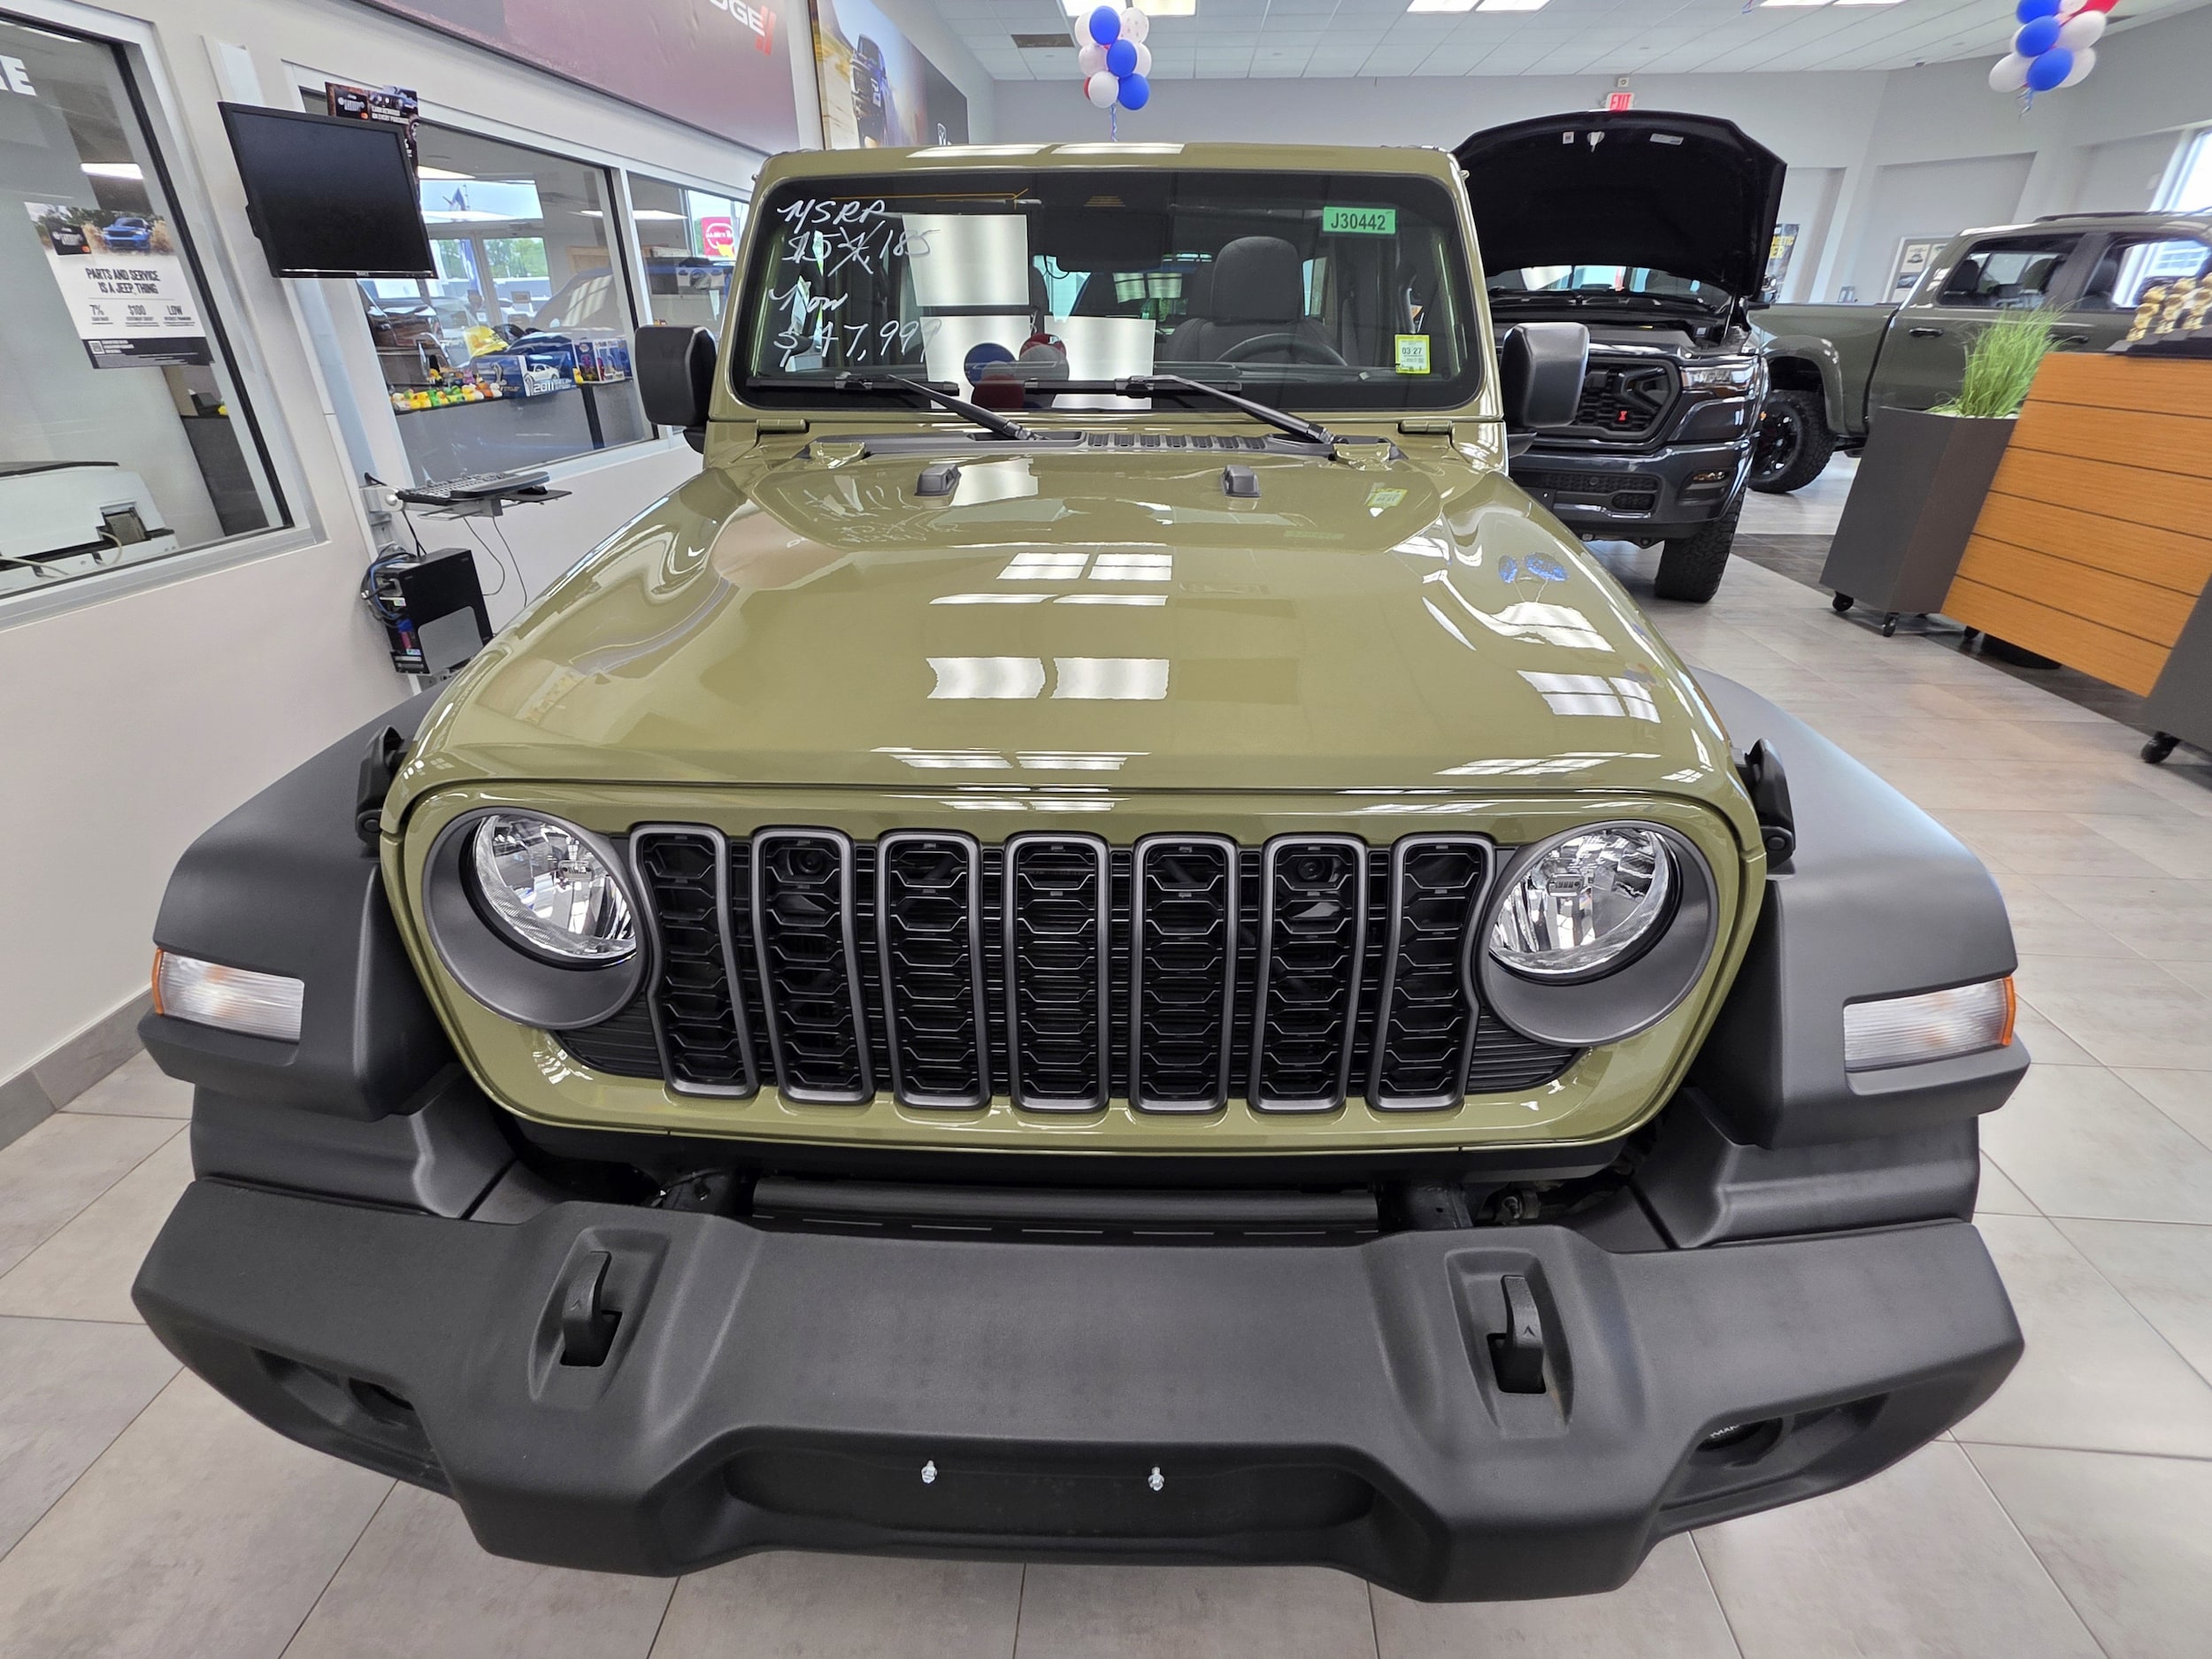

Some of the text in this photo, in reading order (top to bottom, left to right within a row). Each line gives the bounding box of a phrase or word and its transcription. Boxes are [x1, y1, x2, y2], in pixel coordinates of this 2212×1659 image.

[0, 55, 36, 96] E
[1609, 93, 1632, 111] EXIT
[777, 199, 886, 234] MSRP
[1331, 212, 1386, 230] J30442
[86, 268, 160, 281] PARTS AND SERVICE
[98, 282, 108, 293] IS
[108, 282, 116, 293] A
[134, 283, 158, 294] THING
[89, 304, 104, 315] 7%
[128, 304, 146, 315] $100
[167, 305, 183, 315] LOW
[774, 319, 941, 367] $47,999
[534, 382, 555, 393] 2011
